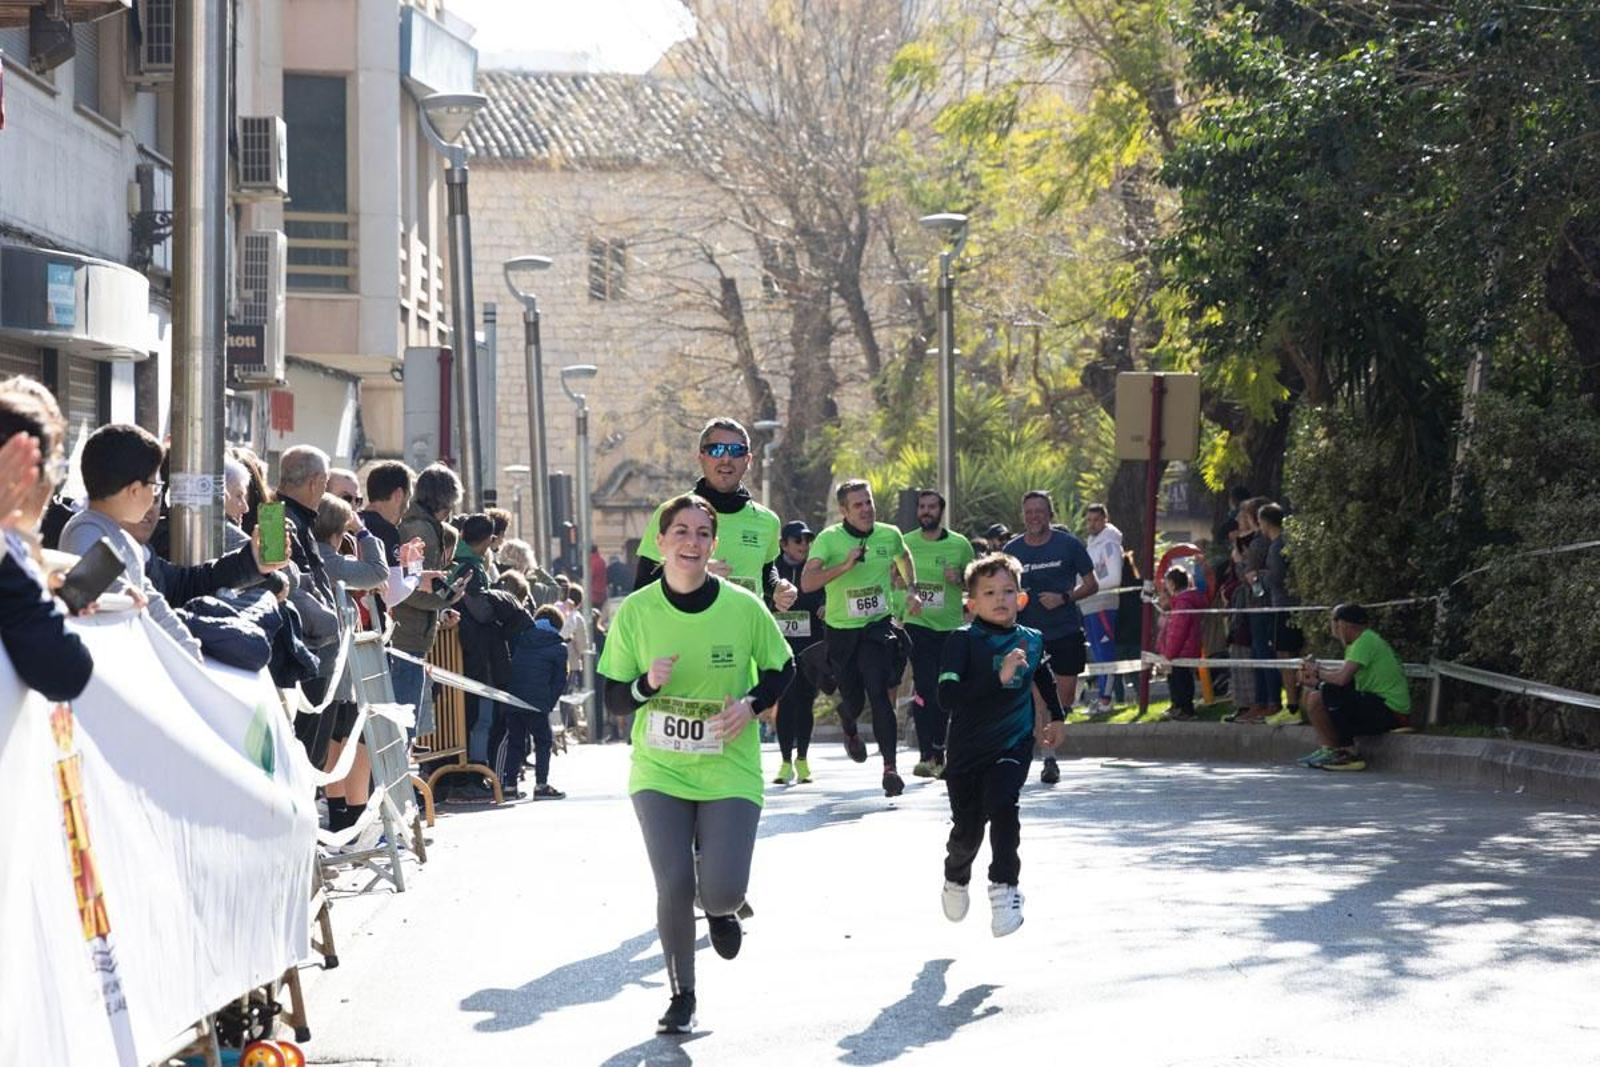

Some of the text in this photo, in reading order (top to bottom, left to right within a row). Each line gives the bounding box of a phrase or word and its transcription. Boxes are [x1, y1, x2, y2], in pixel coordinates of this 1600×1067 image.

[856, 596, 878, 610] 668
[784, 621, 799, 631] 70
[663, 715, 704, 741] 600
